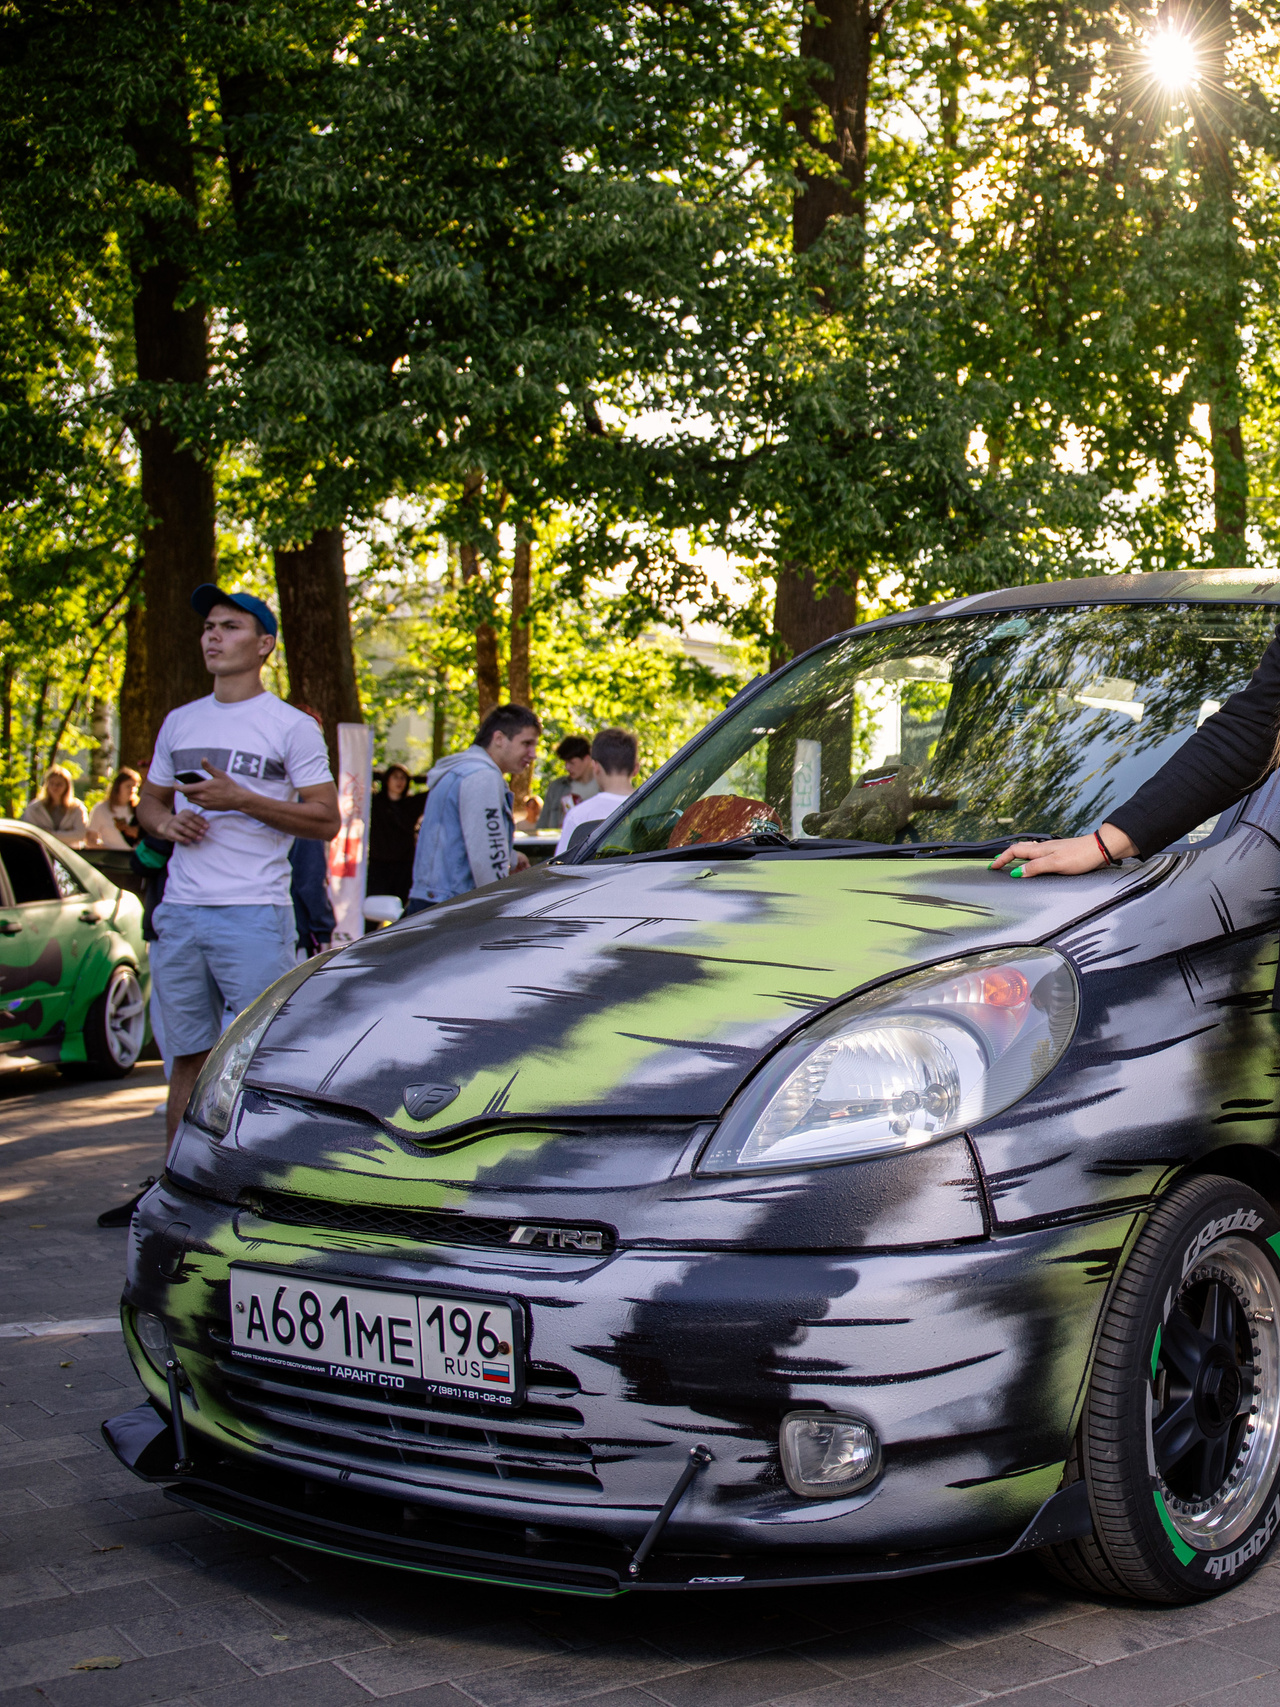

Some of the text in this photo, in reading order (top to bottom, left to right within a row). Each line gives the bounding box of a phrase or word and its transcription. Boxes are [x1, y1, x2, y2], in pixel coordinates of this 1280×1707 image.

[426, 1304, 501, 1360] 196
[329, 1365, 405, 1388] ГАРАНТ СТО
[444, 1356, 481, 1379] RUS
[462, 1389, 512, 1405] 181-02-02
